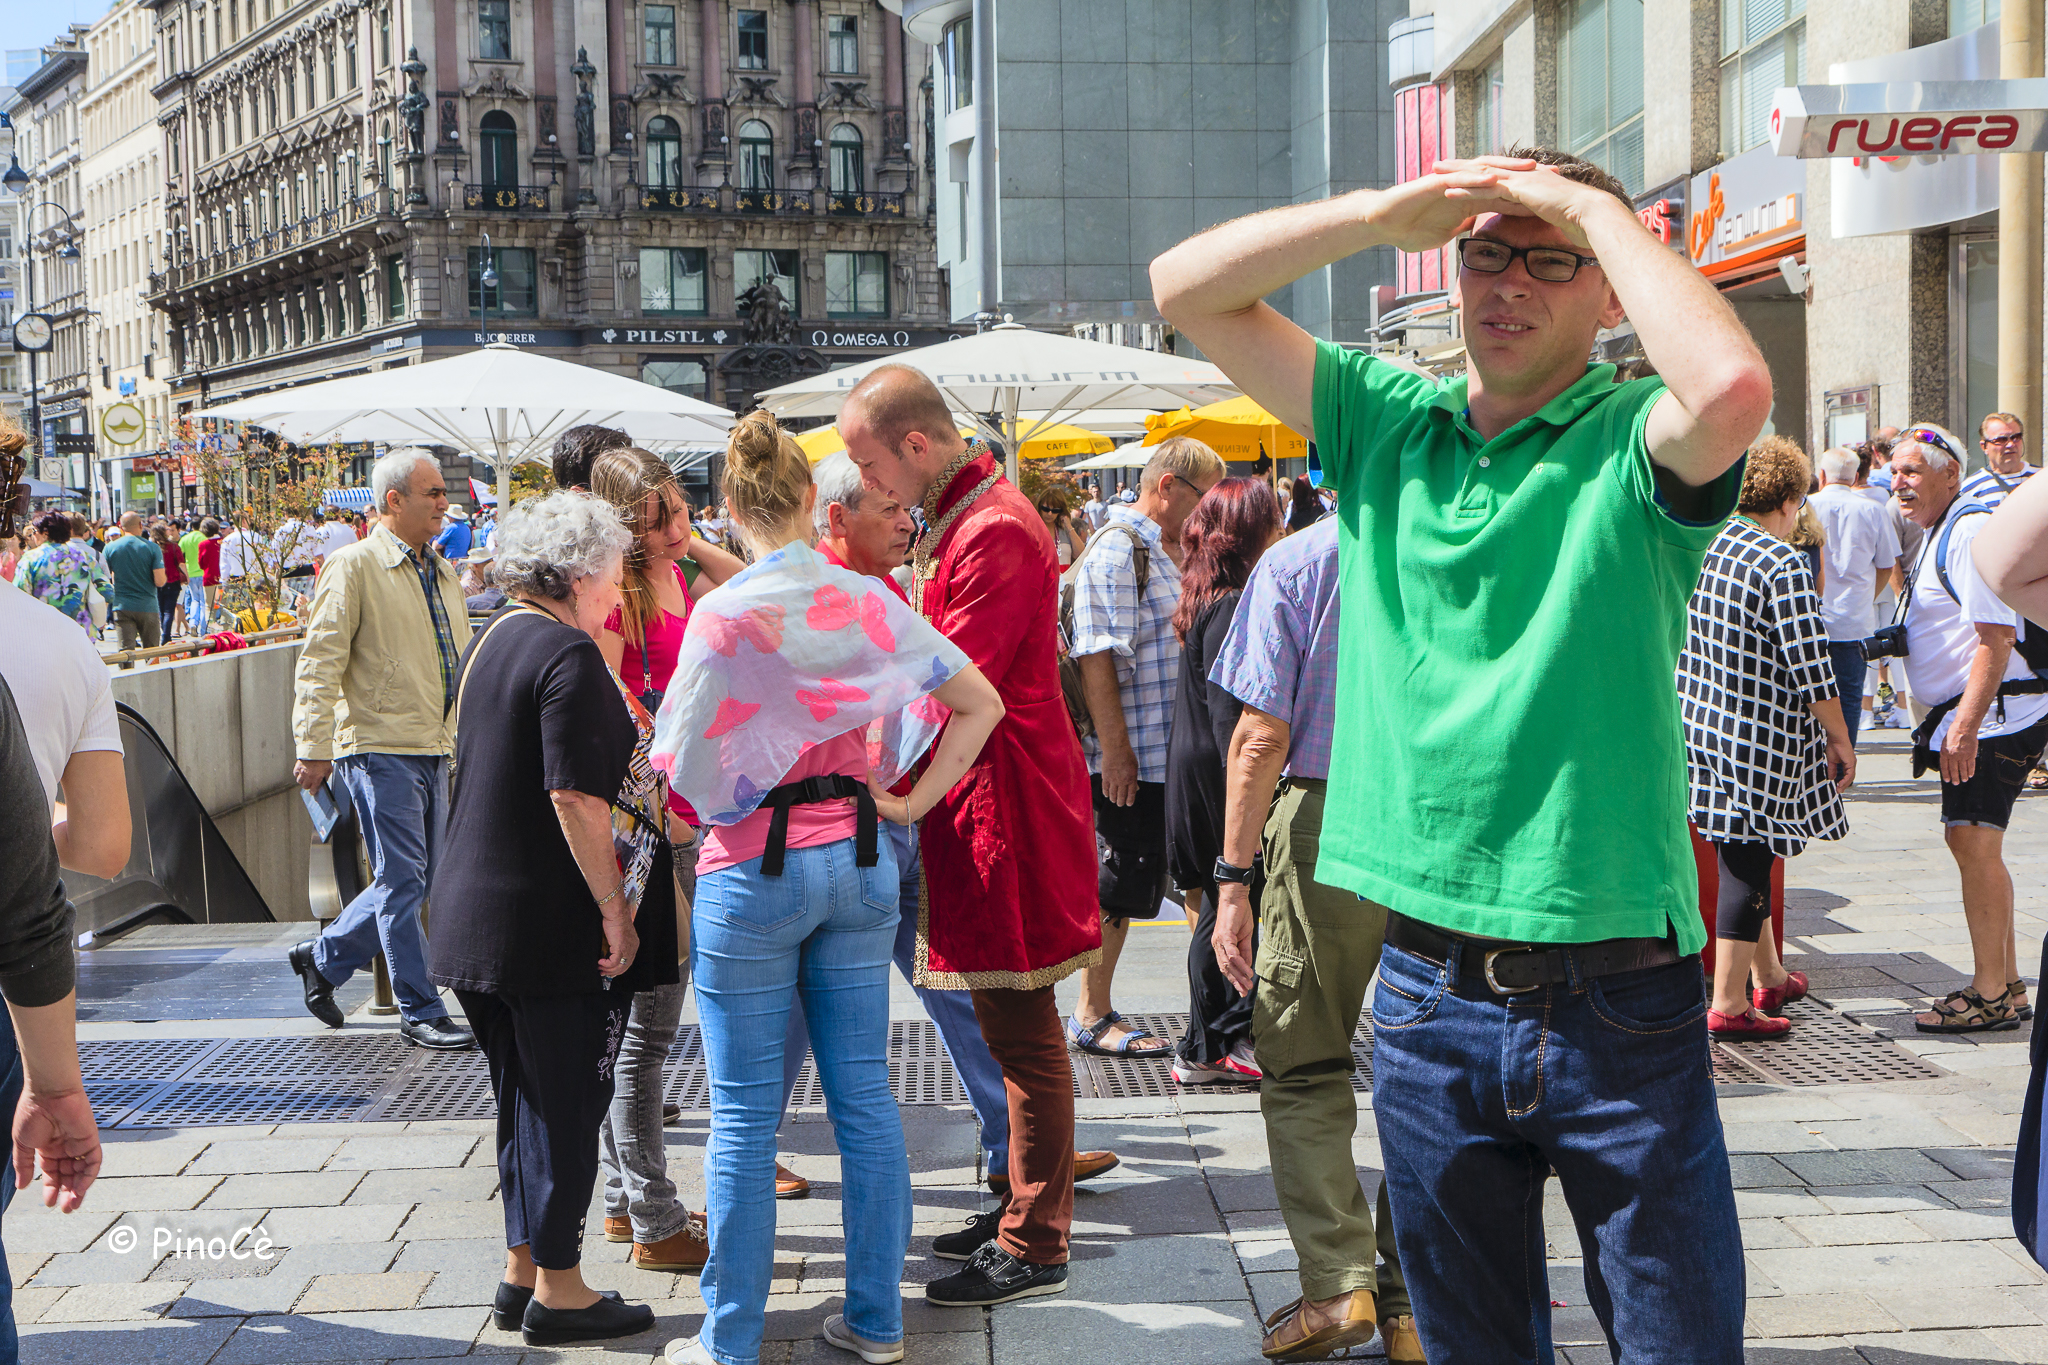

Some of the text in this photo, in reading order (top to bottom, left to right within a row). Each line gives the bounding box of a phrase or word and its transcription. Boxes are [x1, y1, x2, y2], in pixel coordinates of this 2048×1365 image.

[1827, 115, 2019, 153] ruefa
[475, 333, 536, 343] BUCERER
[626, 330, 705, 343] PILSTL
[833, 333, 888, 346] OMEGA
[1046, 442, 1069, 451] CAFE
